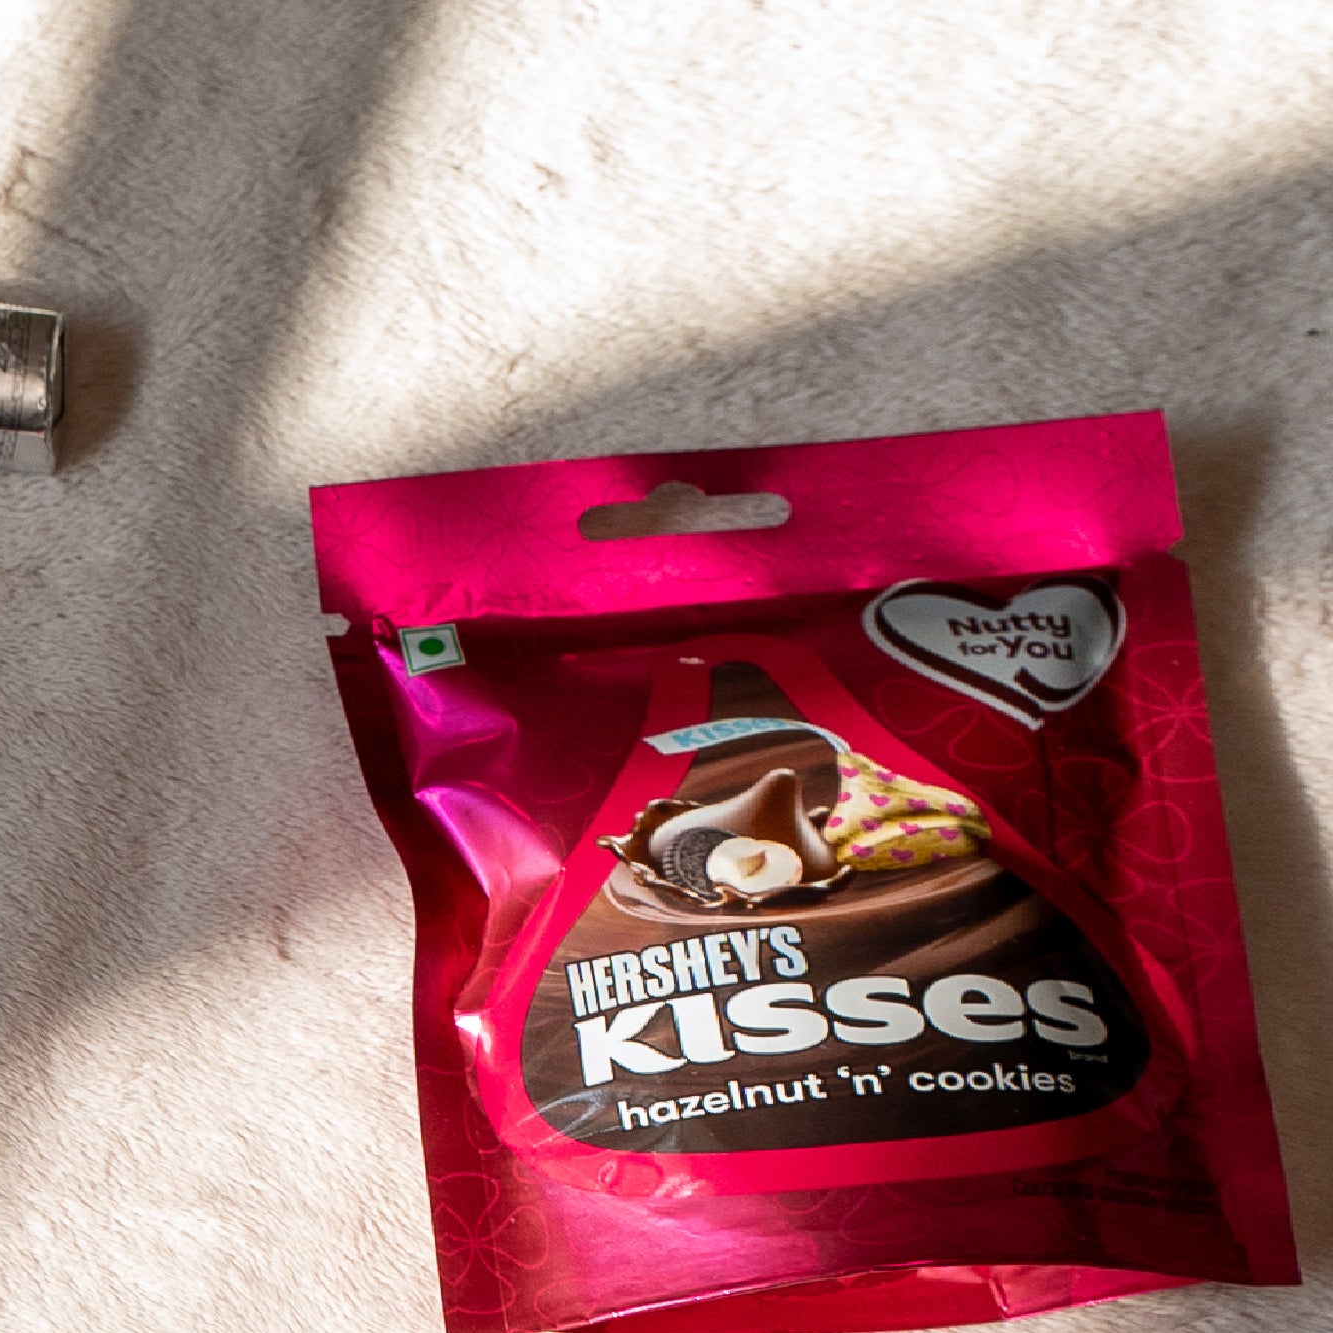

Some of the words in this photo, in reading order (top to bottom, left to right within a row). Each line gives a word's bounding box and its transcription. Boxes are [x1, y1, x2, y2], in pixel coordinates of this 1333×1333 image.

[947, 611, 1071, 638] Nutty
[957, 641, 998, 656] for
[996, 635, 1073, 660] You
[566, 926, 809, 1016] HERSHEY'S
[617, 1081, 827, 1131] hazelnut
[908, 1064, 1076, 1093] cookies
